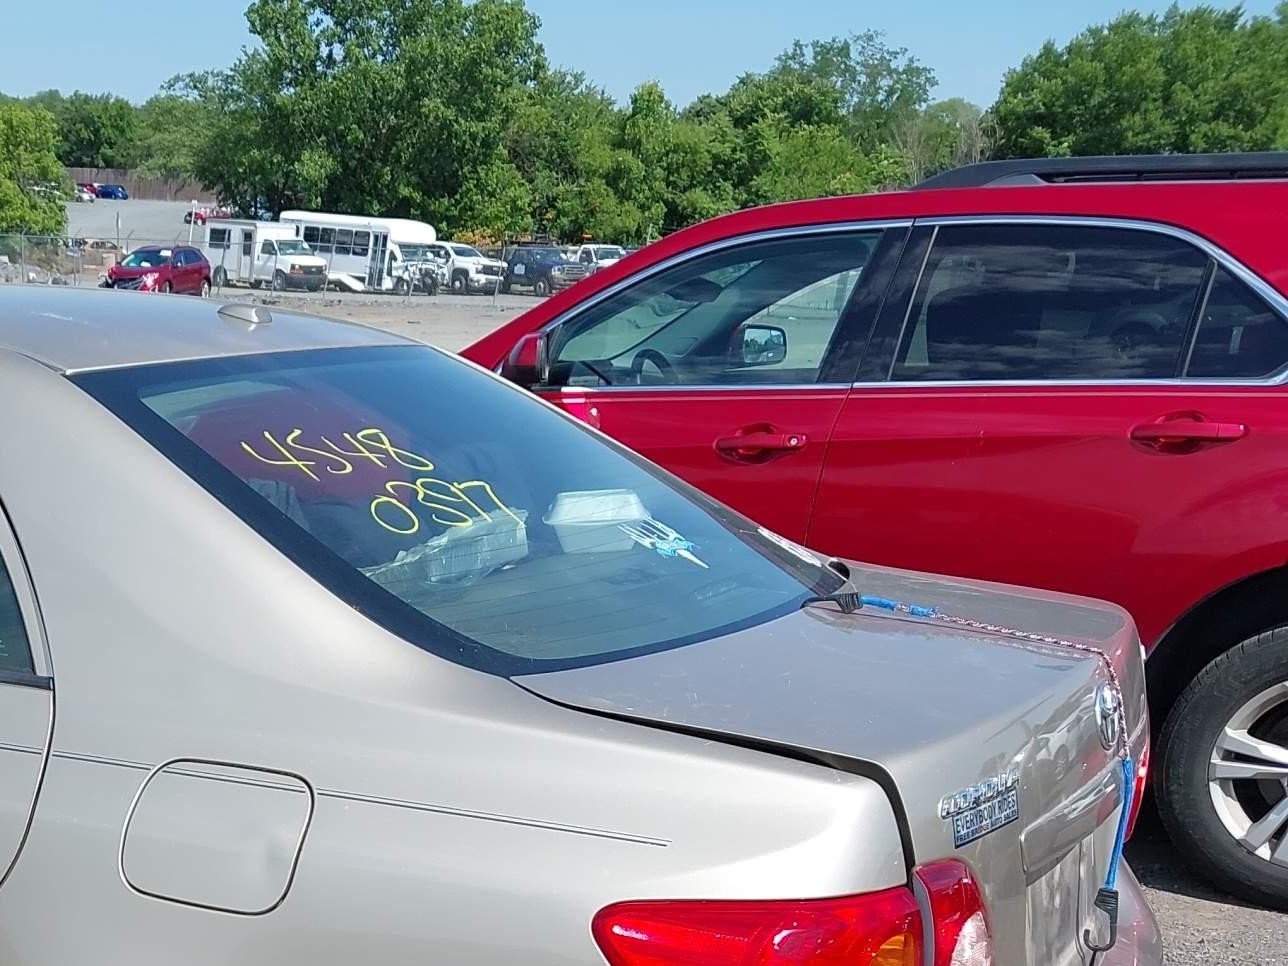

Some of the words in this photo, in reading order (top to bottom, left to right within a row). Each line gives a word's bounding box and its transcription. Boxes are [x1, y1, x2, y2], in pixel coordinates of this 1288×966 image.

[240, 428, 434, 482] 4548
[371, 478, 528, 534] 0397
[955, 800, 999, 833] EVERYBODY
[998, 793, 1016, 814] RIDES
